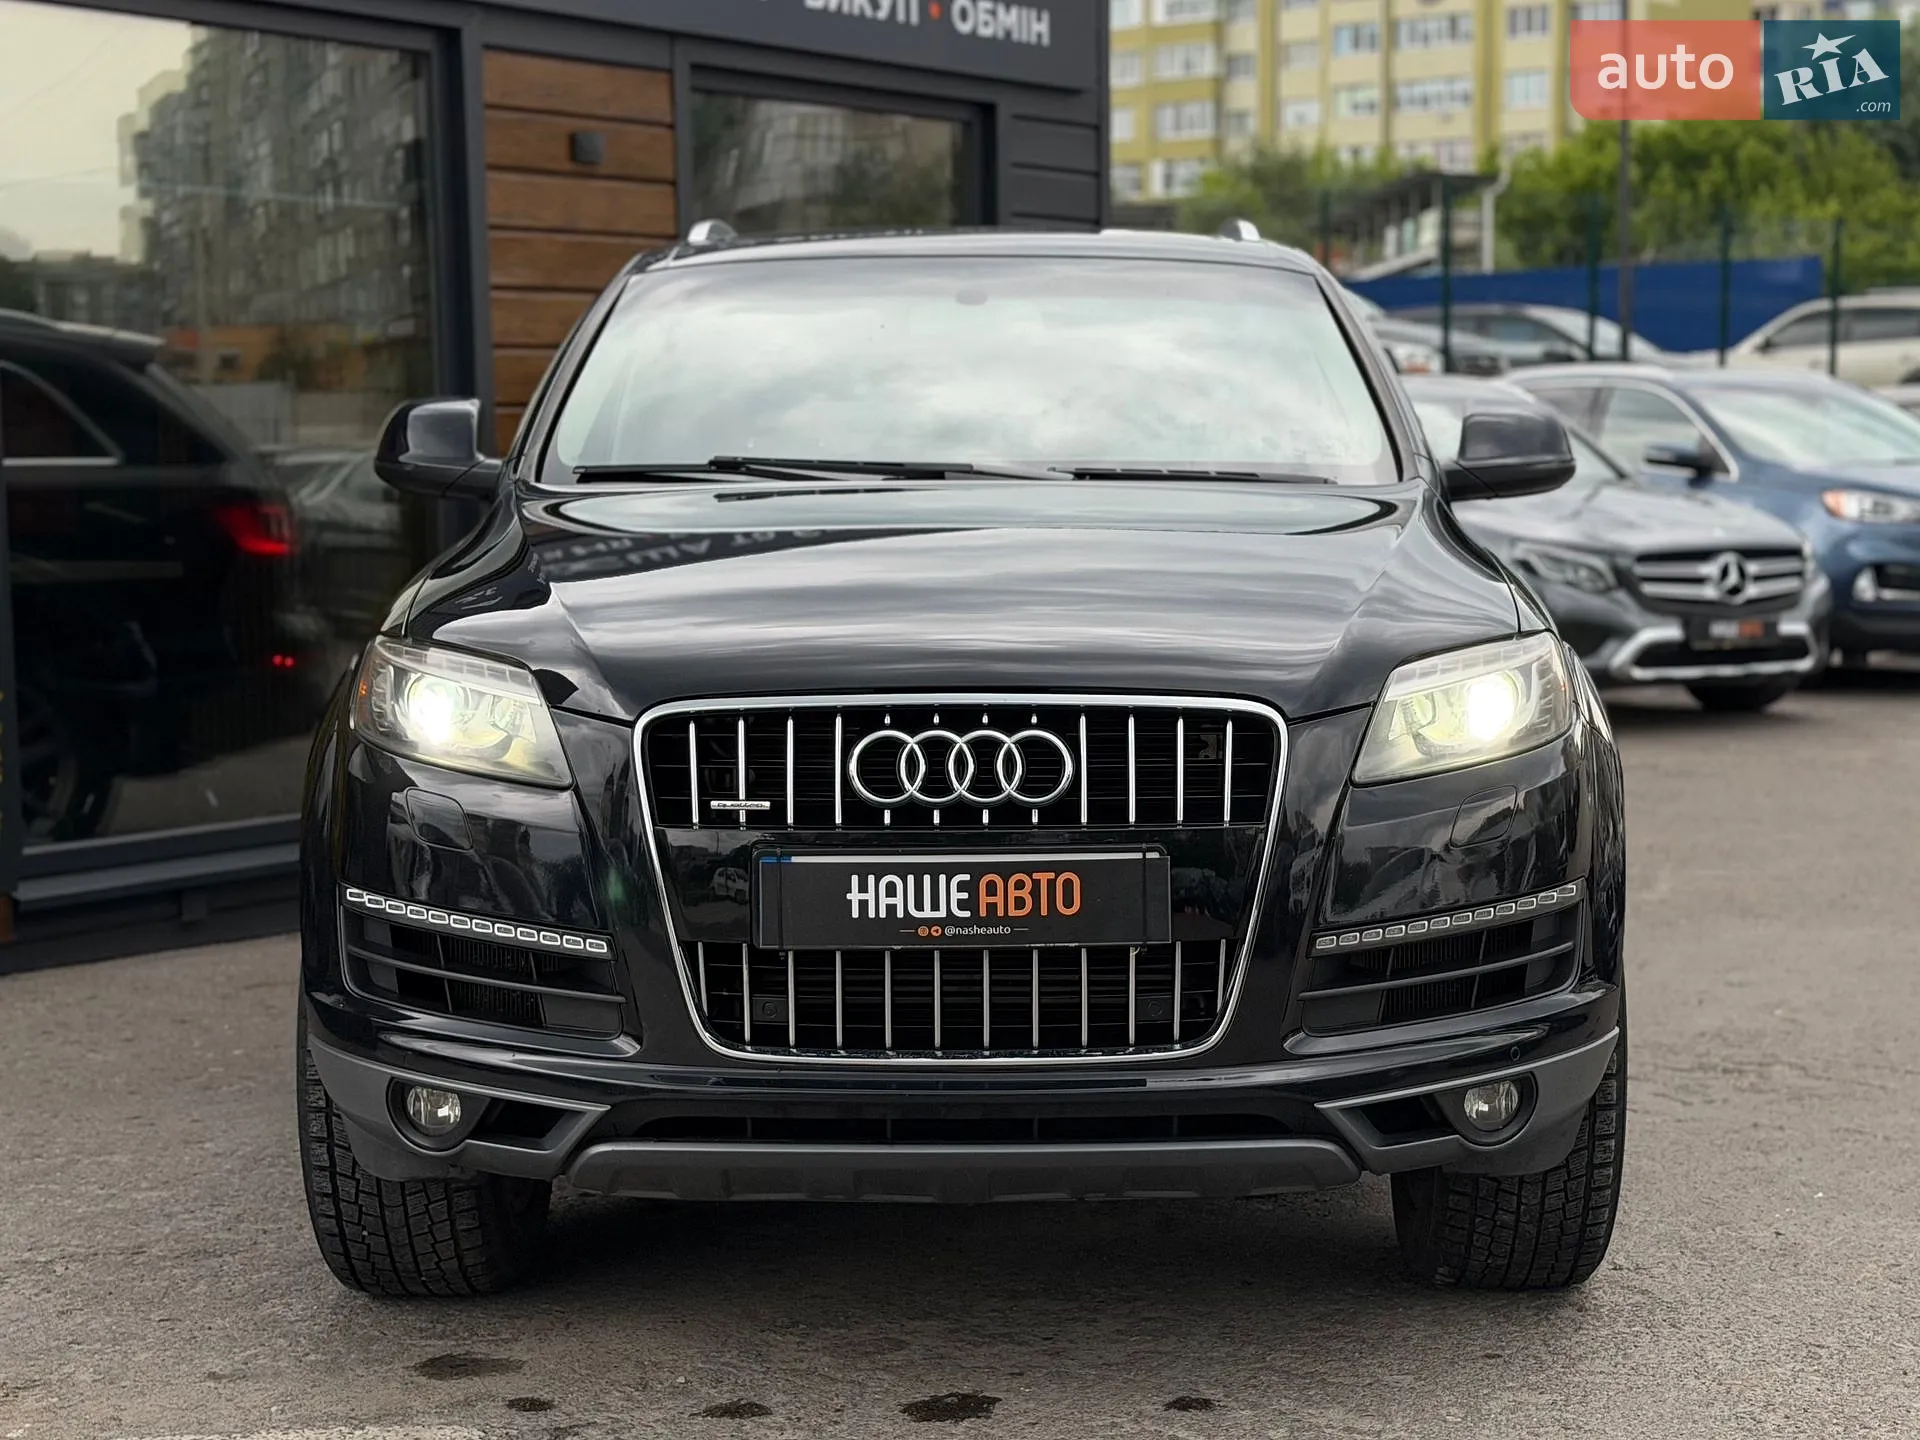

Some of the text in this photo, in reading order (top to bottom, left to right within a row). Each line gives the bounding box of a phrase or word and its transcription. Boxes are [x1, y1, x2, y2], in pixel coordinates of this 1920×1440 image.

[804, 0, 1050, 46] КУП ОБМІН
[846, 872, 1081, 918] НАШЕ АВТО
[944, 924, 1011, 937] @nasheauto
